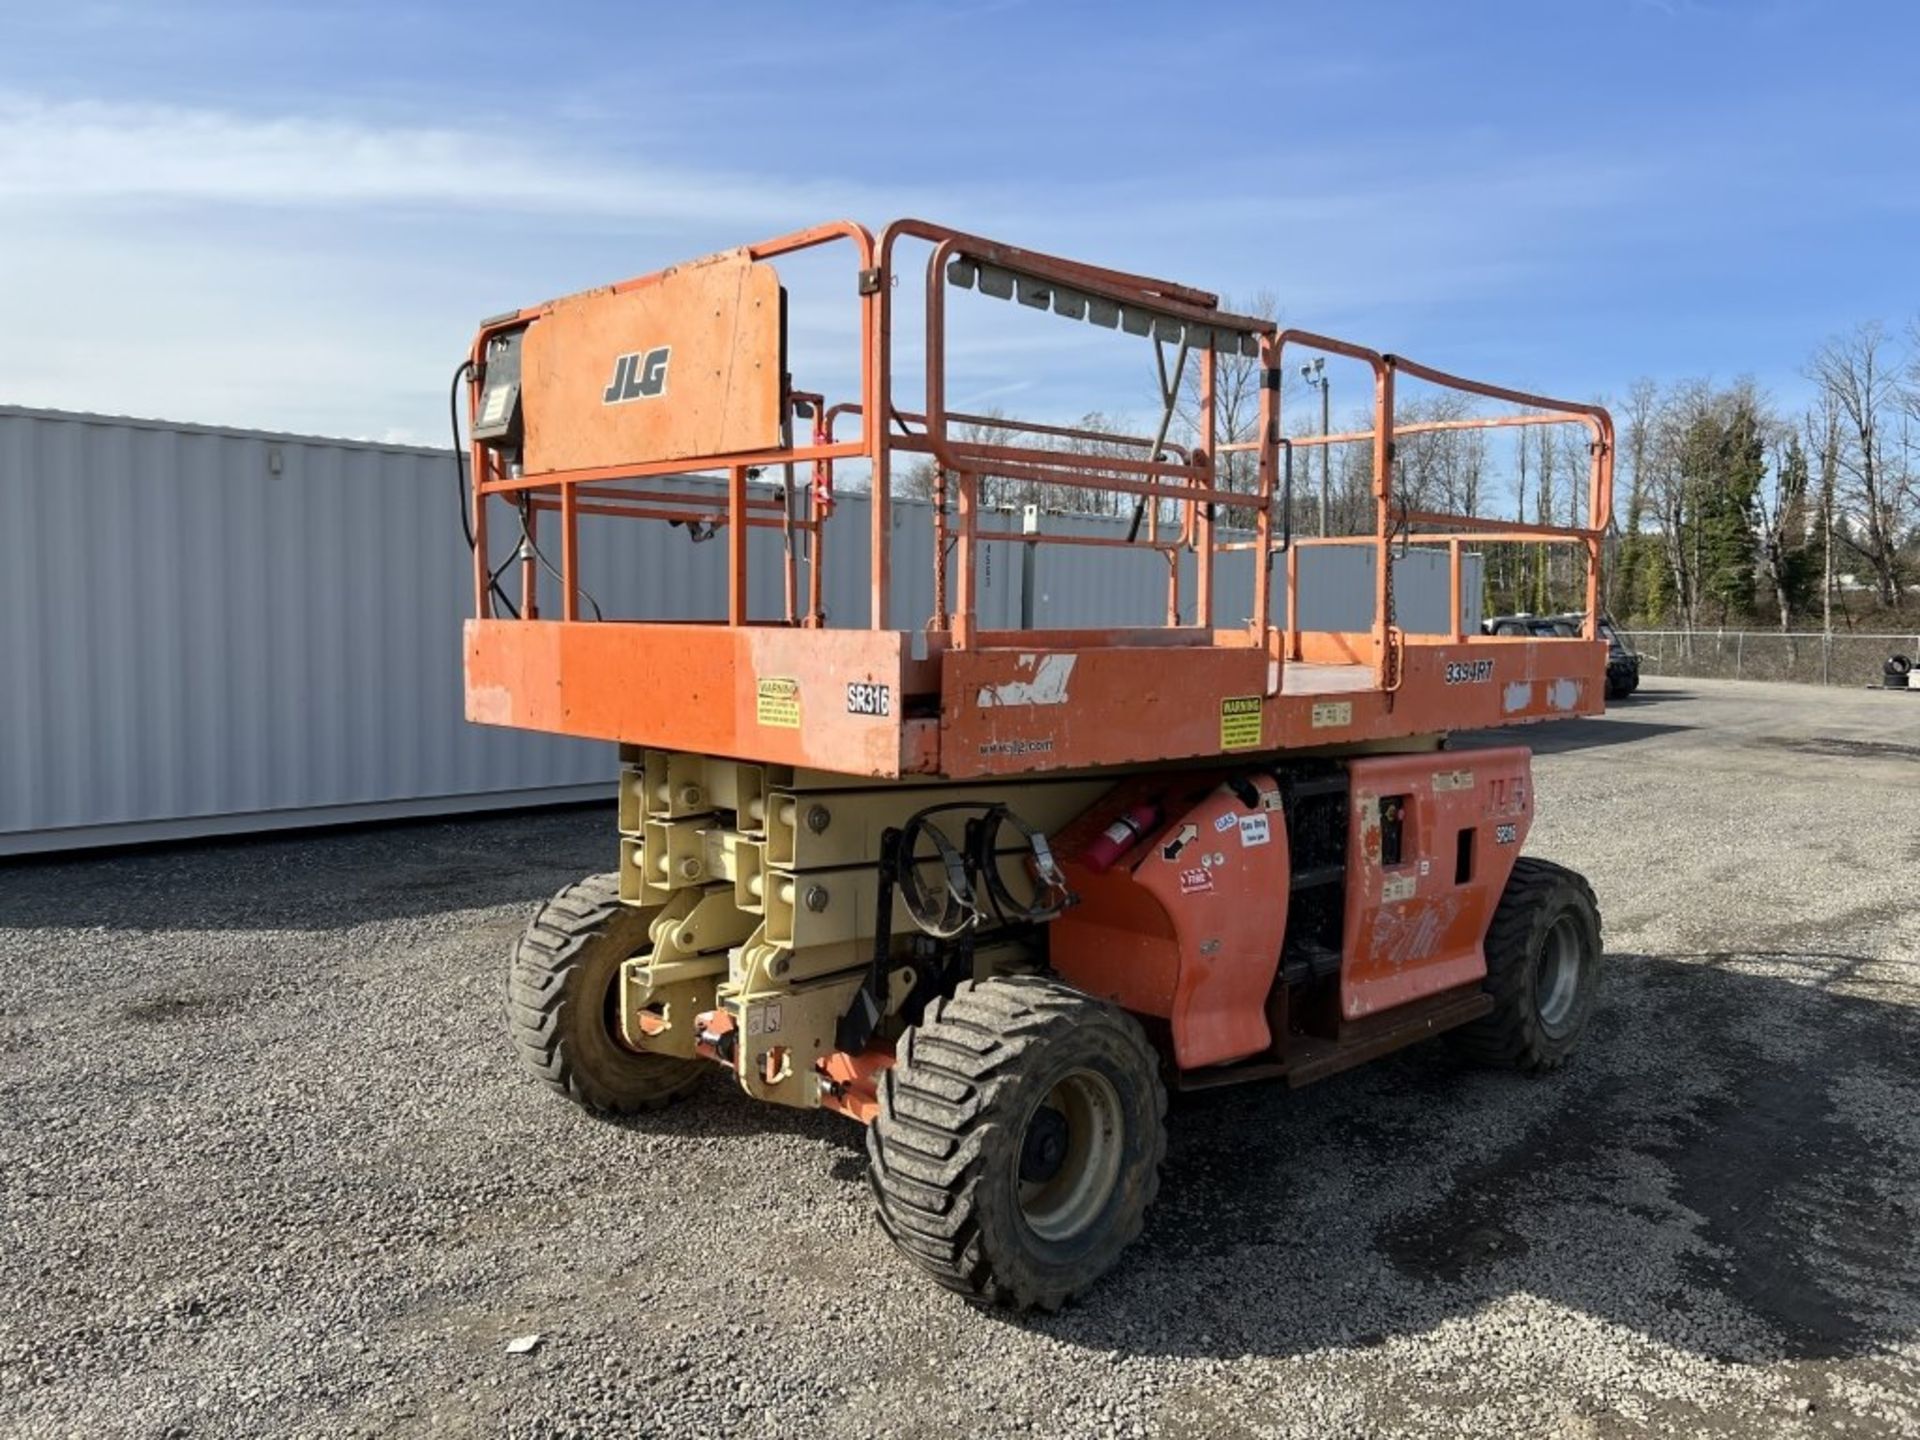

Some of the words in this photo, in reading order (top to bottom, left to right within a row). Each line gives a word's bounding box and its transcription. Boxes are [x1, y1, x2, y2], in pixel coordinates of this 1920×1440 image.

[603, 346, 671, 404] JLG
[848, 685, 888, 715] SR316
[1216, 816, 1236, 830] GAS
